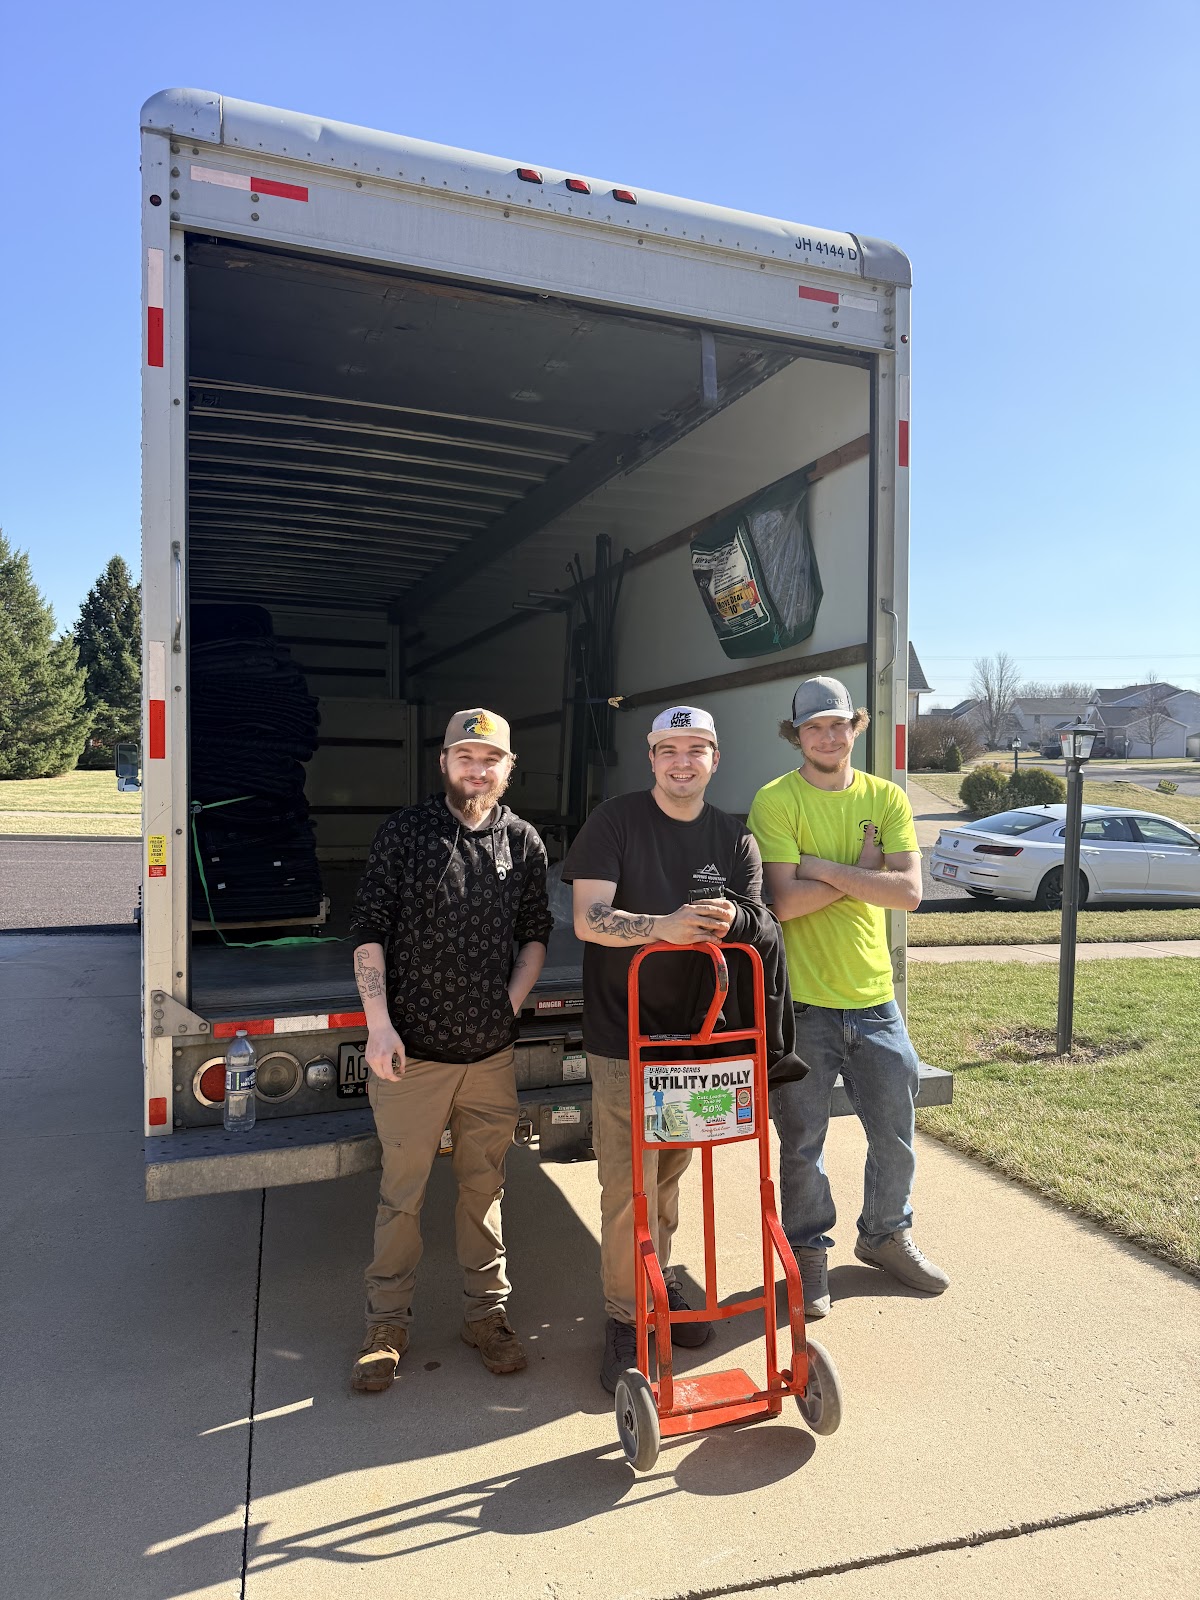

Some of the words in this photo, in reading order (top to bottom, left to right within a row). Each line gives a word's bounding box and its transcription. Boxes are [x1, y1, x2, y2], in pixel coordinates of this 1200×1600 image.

[795, 237, 812, 251] JH
[816, 241, 844, 258] 4144
[848, 247, 857, 260] D
[538, 1000, 562, 1009] DANGER
[649, 1075, 708, 1090] UTILITY
[711, 1070, 750, 1088] DOLLY
[702, 1104, 723, 1113] 50%
